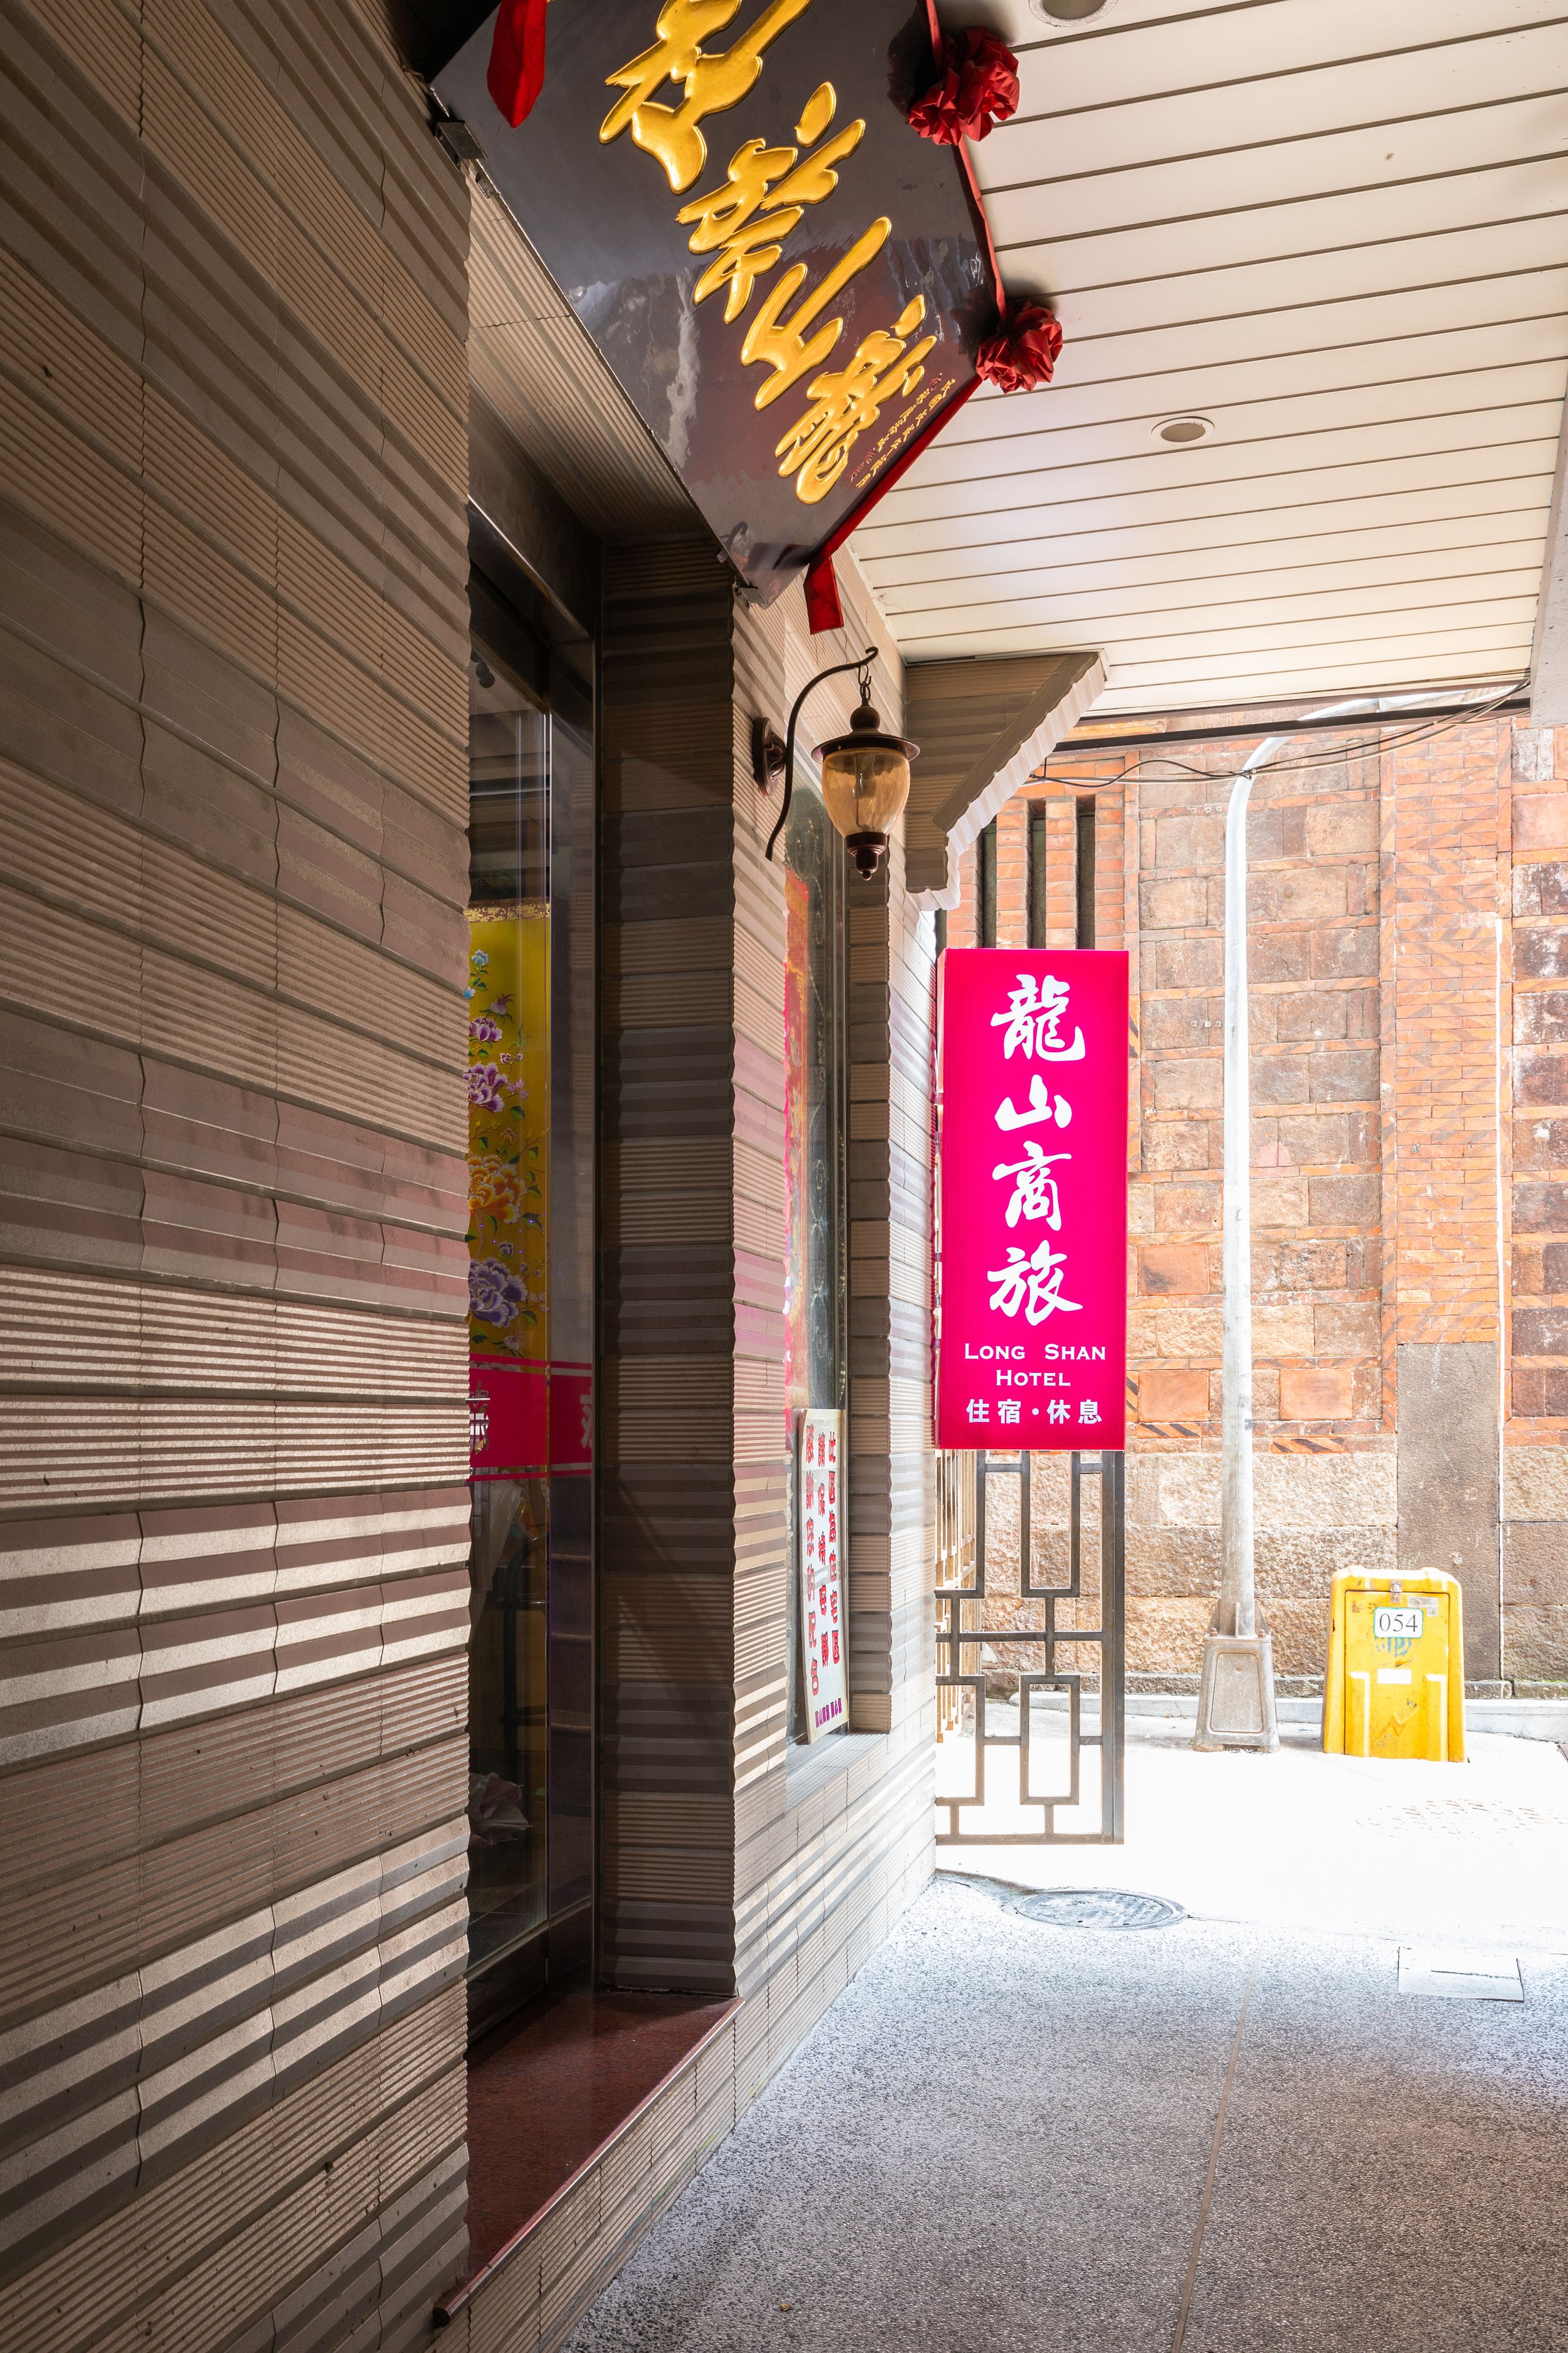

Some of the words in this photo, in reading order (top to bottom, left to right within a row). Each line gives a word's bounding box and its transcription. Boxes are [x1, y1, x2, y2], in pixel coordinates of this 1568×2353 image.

[987, 974, 1085, 1325] 龍山商旅
[1379, 1613, 1418, 1632] 054
